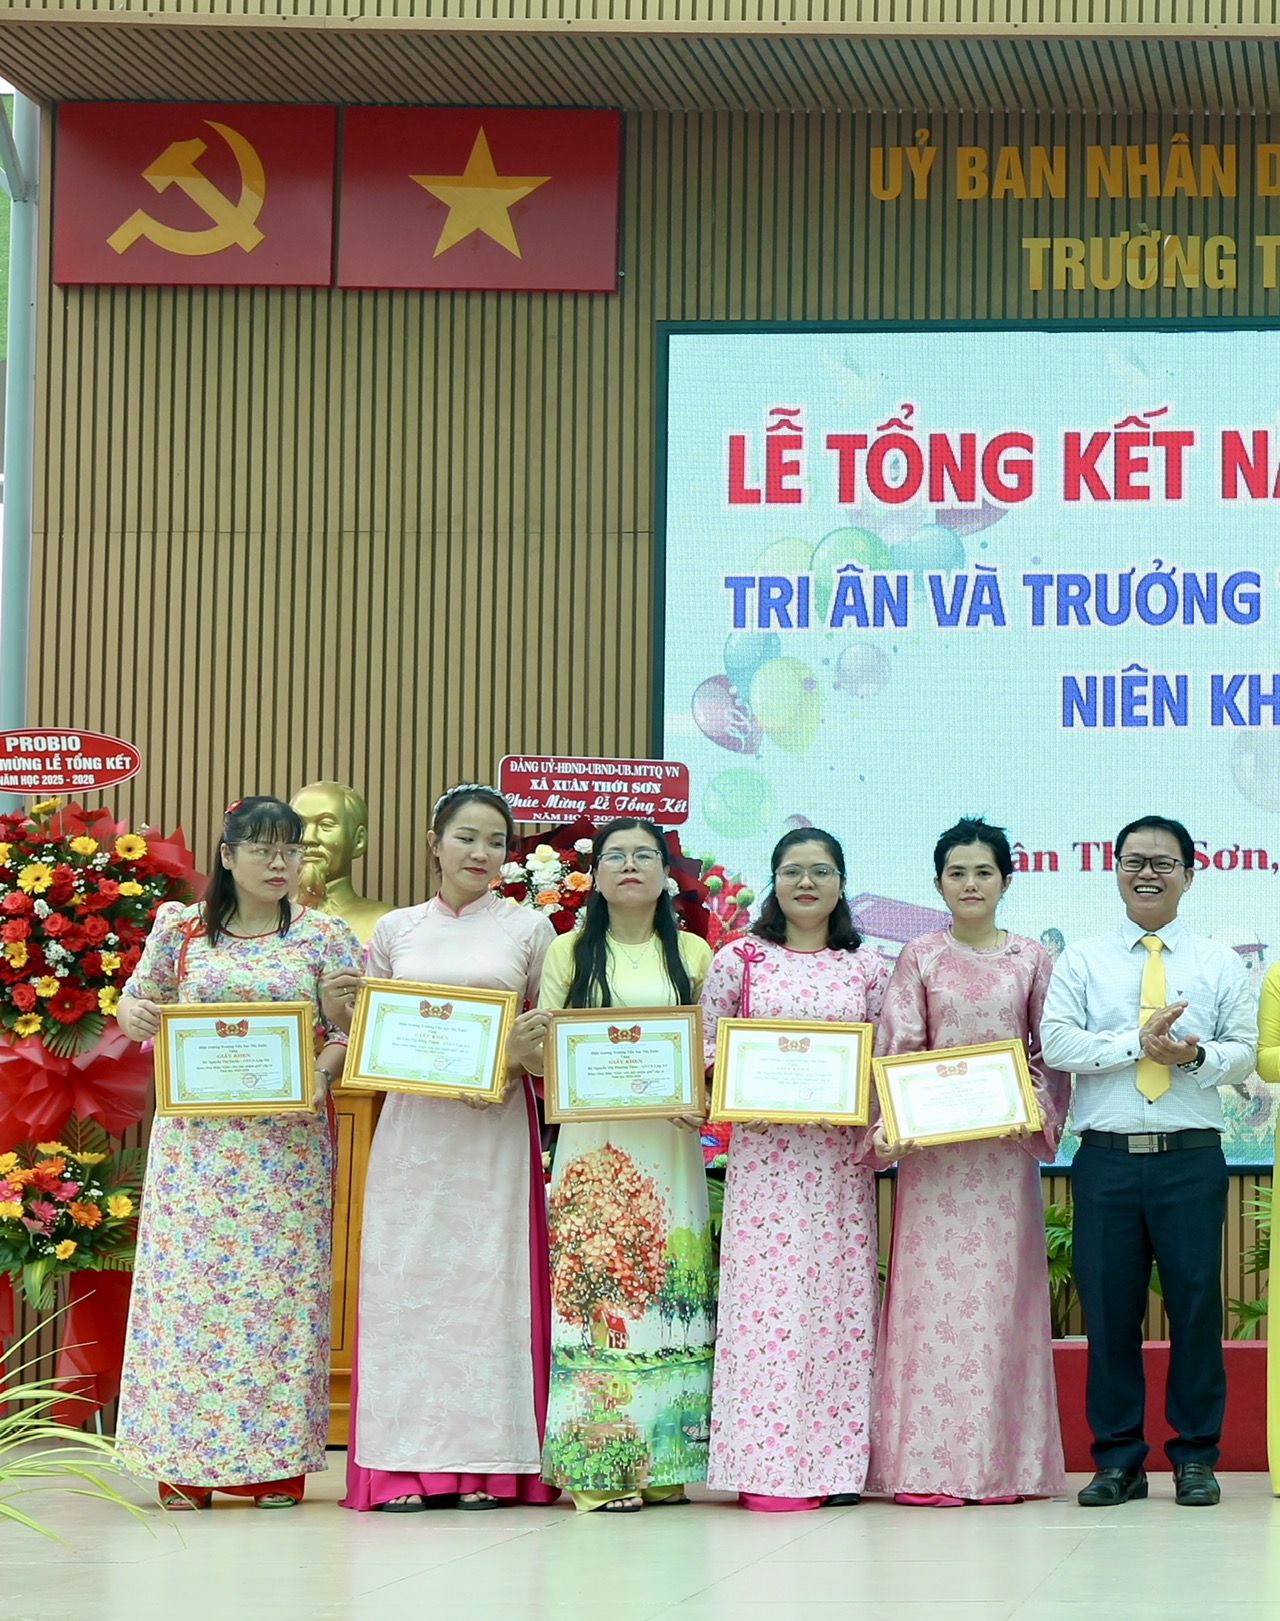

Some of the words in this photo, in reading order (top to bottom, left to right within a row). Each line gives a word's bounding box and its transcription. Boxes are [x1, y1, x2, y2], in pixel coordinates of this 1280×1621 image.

[869, 127, 937, 201] UỶ
[955, 145, 1066, 200] BAN
[1086, 132, 1236, 199] NHÂN
[1021, 221, 1237, 292] TRƯỜNG
[727, 408, 804, 505] LỄ
[825, 402, 1034, 504] TỔNG
[1062, 405, 1195, 501] KẾT
[724, 575, 809, 629] TRI
[829, 563, 909, 628] ÂN
[927, 563, 1007, 628] VÀ
[1022, 558, 1262, 627] TRƯỞNG
[1061, 663, 1188, 728] NIÊN
[5, 735, 81, 752] PROBIO
[0, 755, 42, 771] MỪNG
[45, 753, 62, 770] LỄ
[65, 753, 102, 770] TỔNG
[106, 753, 131, 770] KẾT
[509, 758, 539, 773] ĐẢNG
[665, 766, 680, 778] VN
[20, 775, 39, 787] HỌC
[41, 775, 64, 785] 2025
[72, 774, 95, 785] 2026
[529, 777, 549, 791] XÃ
[552, 778, 590, 792] XUÂN
[591, 779, 629, 793] THỚI
[631, 781, 662, 794] SƠN
[505, 792, 540, 808] Chúc
[541, 794, 587, 813] Mừng
[589, 795, 610, 810] Lễ
[614, 796, 656, 815] Tổng
[658, 797, 688, 813] Kết
[532, 812, 561, 820] NĂM
